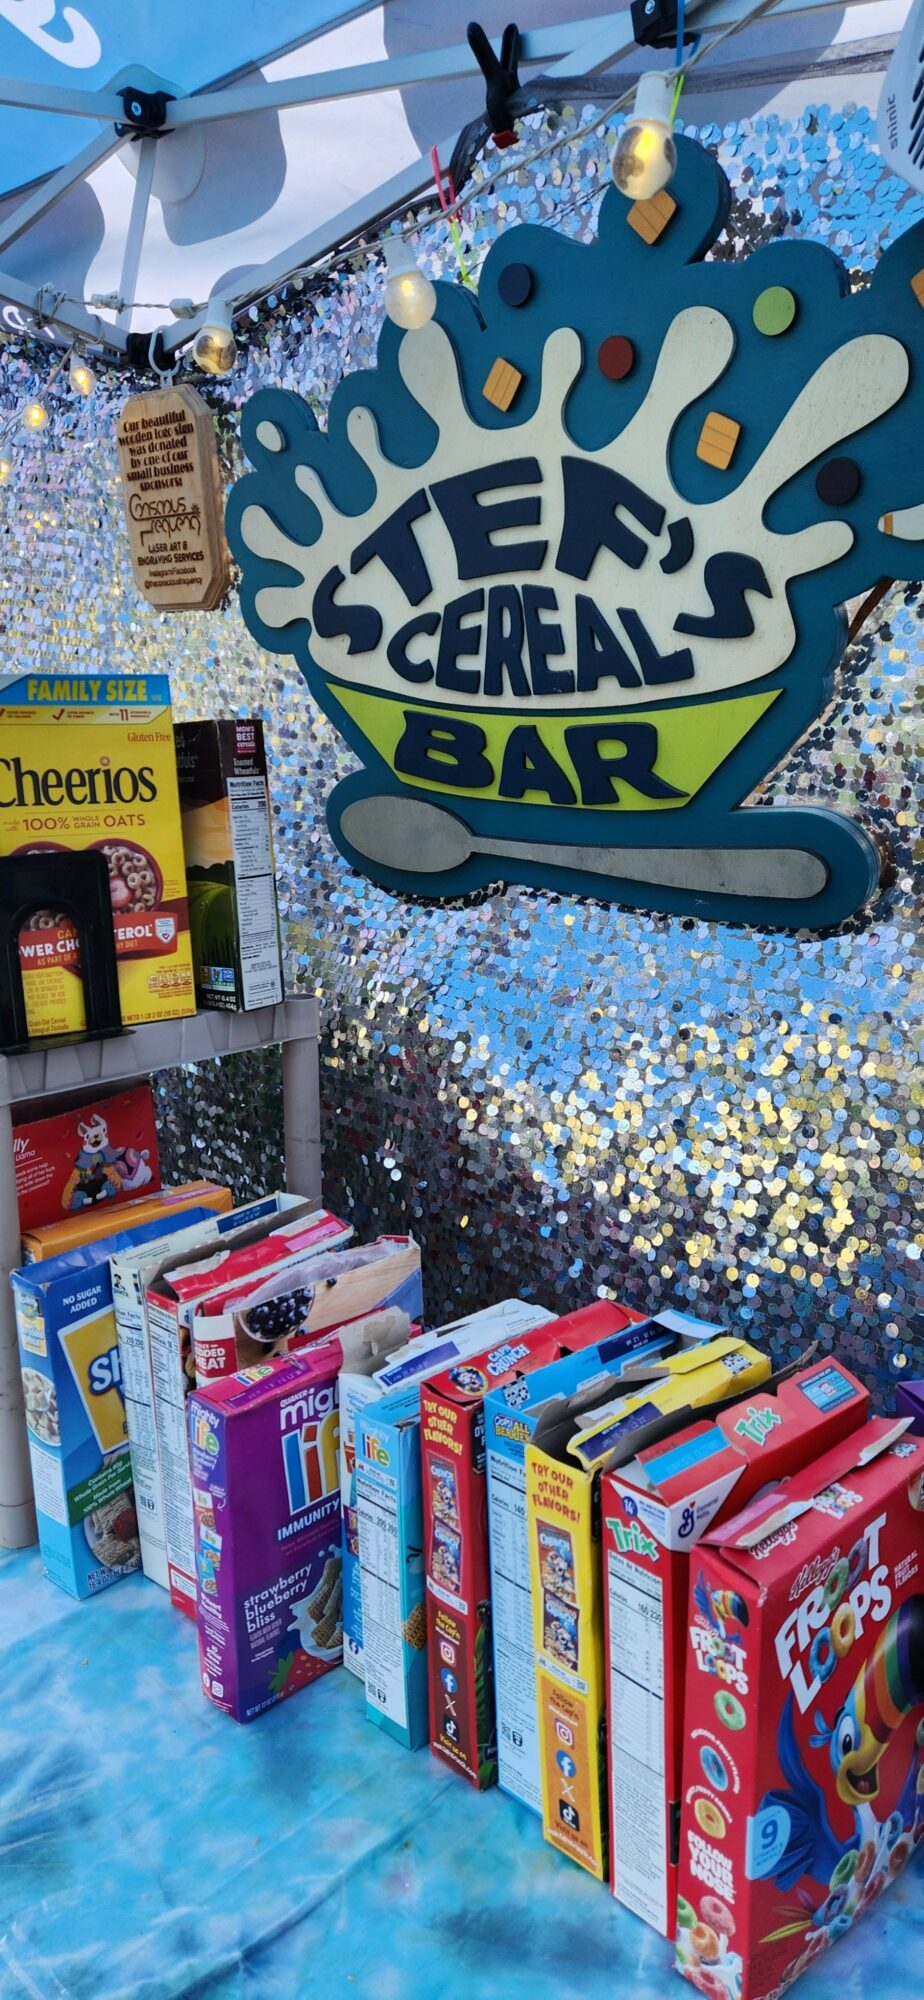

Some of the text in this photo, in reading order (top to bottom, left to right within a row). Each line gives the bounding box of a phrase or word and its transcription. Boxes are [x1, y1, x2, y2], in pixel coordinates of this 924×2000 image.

[889, 93, 899, 150] shinic
[118, 423, 194, 446] wooden logo sign
[123, 410, 186, 432] Our beautiful
[129, 436, 188, 456] was donated
[130, 450, 189, 469] by one of our
[127, 462, 194, 481] small business
[140, 477, 183, 492] sponsors:
[137, 550, 205, 567] ENGRAVING SERVICES
[148, 543, 168, 554] LASER
[169, 541, 181, 552] ART
[312, 456, 773, 656] STEF'S
[386, 584, 695, 697] CEREAL
[28, 680, 148, 701] FAMILY SIZE
[128, 732, 172, 742] Gluten Free
[236, 732, 255, 741] BEST
[393, 710, 691, 806] BAR
[23, 817, 70, 831] 100%
[74, 821, 100, 829] GRAIN
[103, 814, 146, 828] OATS
[62, 1285, 102, 1306] NO SUGAR
[70, 1297, 97, 1314] ADDED
[487, 1344, 531, 1376] CRUNCH
[280, 1389, 308, 1407] QUAKER
[191, 1400, 220, 1429] mighty
[423, 1400, 458, 1424] TRY OUR
[191, 1413, 219, 1456] life
[428, 1416, 454, 1436] OTHER
[733, 1405, 782, 1447] Trix
[362, 1432, 390, 1469] life
[424, 1428, 463, 1456] FLAVORS!
[281, 1408, 341, 1516] lif
[532, 1462, 574, 1488] TRY OUR
[538, 1481, 569, 1500] OTHER
[277, 1498, 340, 1542] IMMUNITY
[532, 1493, 581, 1524] FLAVORS!
[605, 1517, 660, 1562] Trix
[894, 1550, 918, 1572] NATURAL
[244, 1563, 312, 1609] strawberry
[895, 1564, 919, 1589] FLAVORS
[244, 1578, 308, 1622] blueberry
[774, 1512, 887, 1681] FROOT
[246, 1611, 276, 1634] bliss
[689, 1626, 748, 1672] FROOT
[789, 1565, 892, 1716] LOOPS
[696, 1649, 749, 1696] LOOPS
[761, 1819, 778, 1850] 9
[687, 1829, 733, 1871] FOLLOW
[688, 1841, 734, 1889] YOUR
[690, 1858, 737, 1905] NOSE
